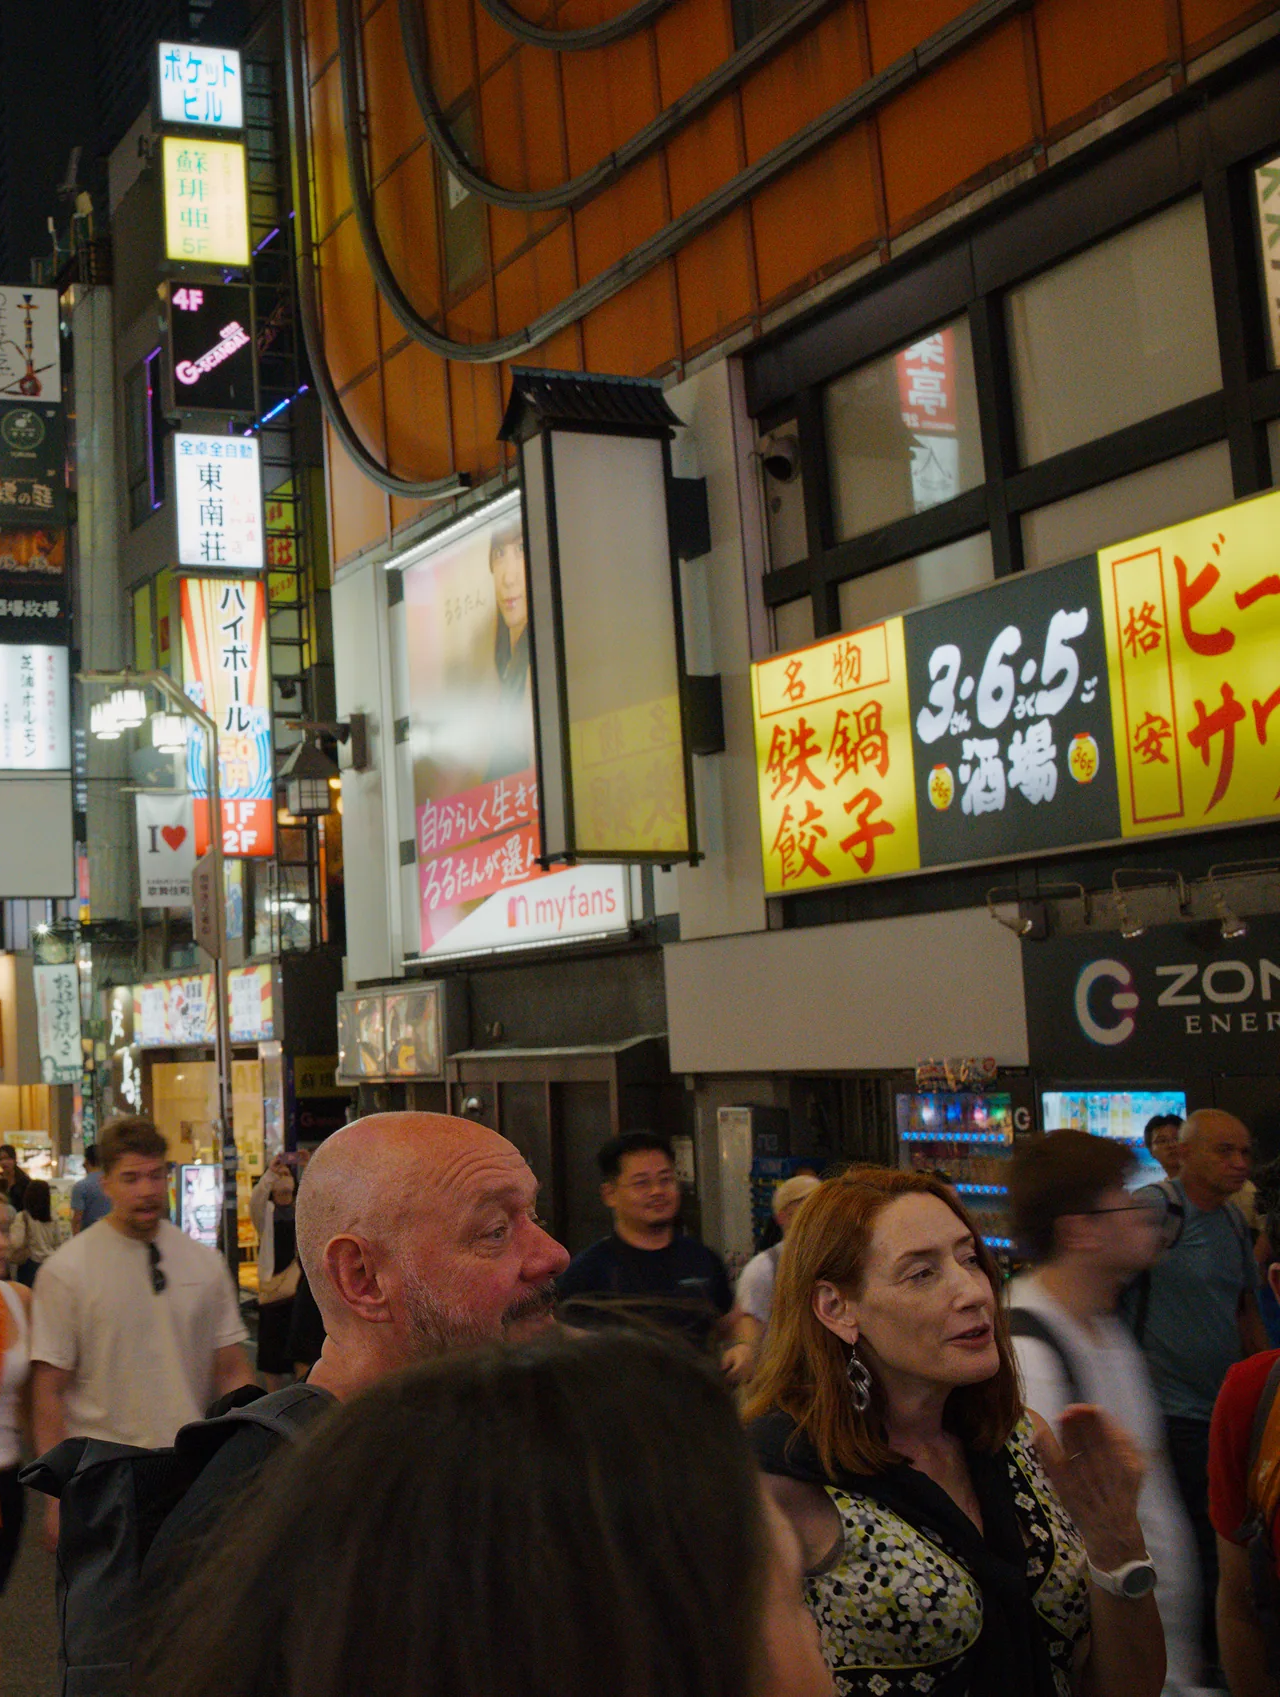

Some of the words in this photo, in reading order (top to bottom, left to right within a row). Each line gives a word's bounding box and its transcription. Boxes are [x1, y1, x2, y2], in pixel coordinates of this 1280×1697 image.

[165, 51, 236, 88] ポケット
[184, 87, 223, 121] ビル
[182, 238, 208, 255] 5F
[172, 288, 203, 311] 4F
[180, 440, 253, 459] 全卓全自動
[197, 463, 226, 562] 東南荘
[220, 586, 251, 732] ハイボール
[781, 640, 863, 702] 名物
[1123, 600, 1172, 766] 格安
[765, 700, 890, 800] 鉄鍋
[958, 718, 1058, 817] 酒場
[1073, 745, 1094, 778] 365
[224, 801, 256, 824] 1F
[148, 825, 160, 853] I
[223, 830, 257, 853] 2F
[770, 788, 895, 887] 餃子
[534, 884, 617, 931] myfans
